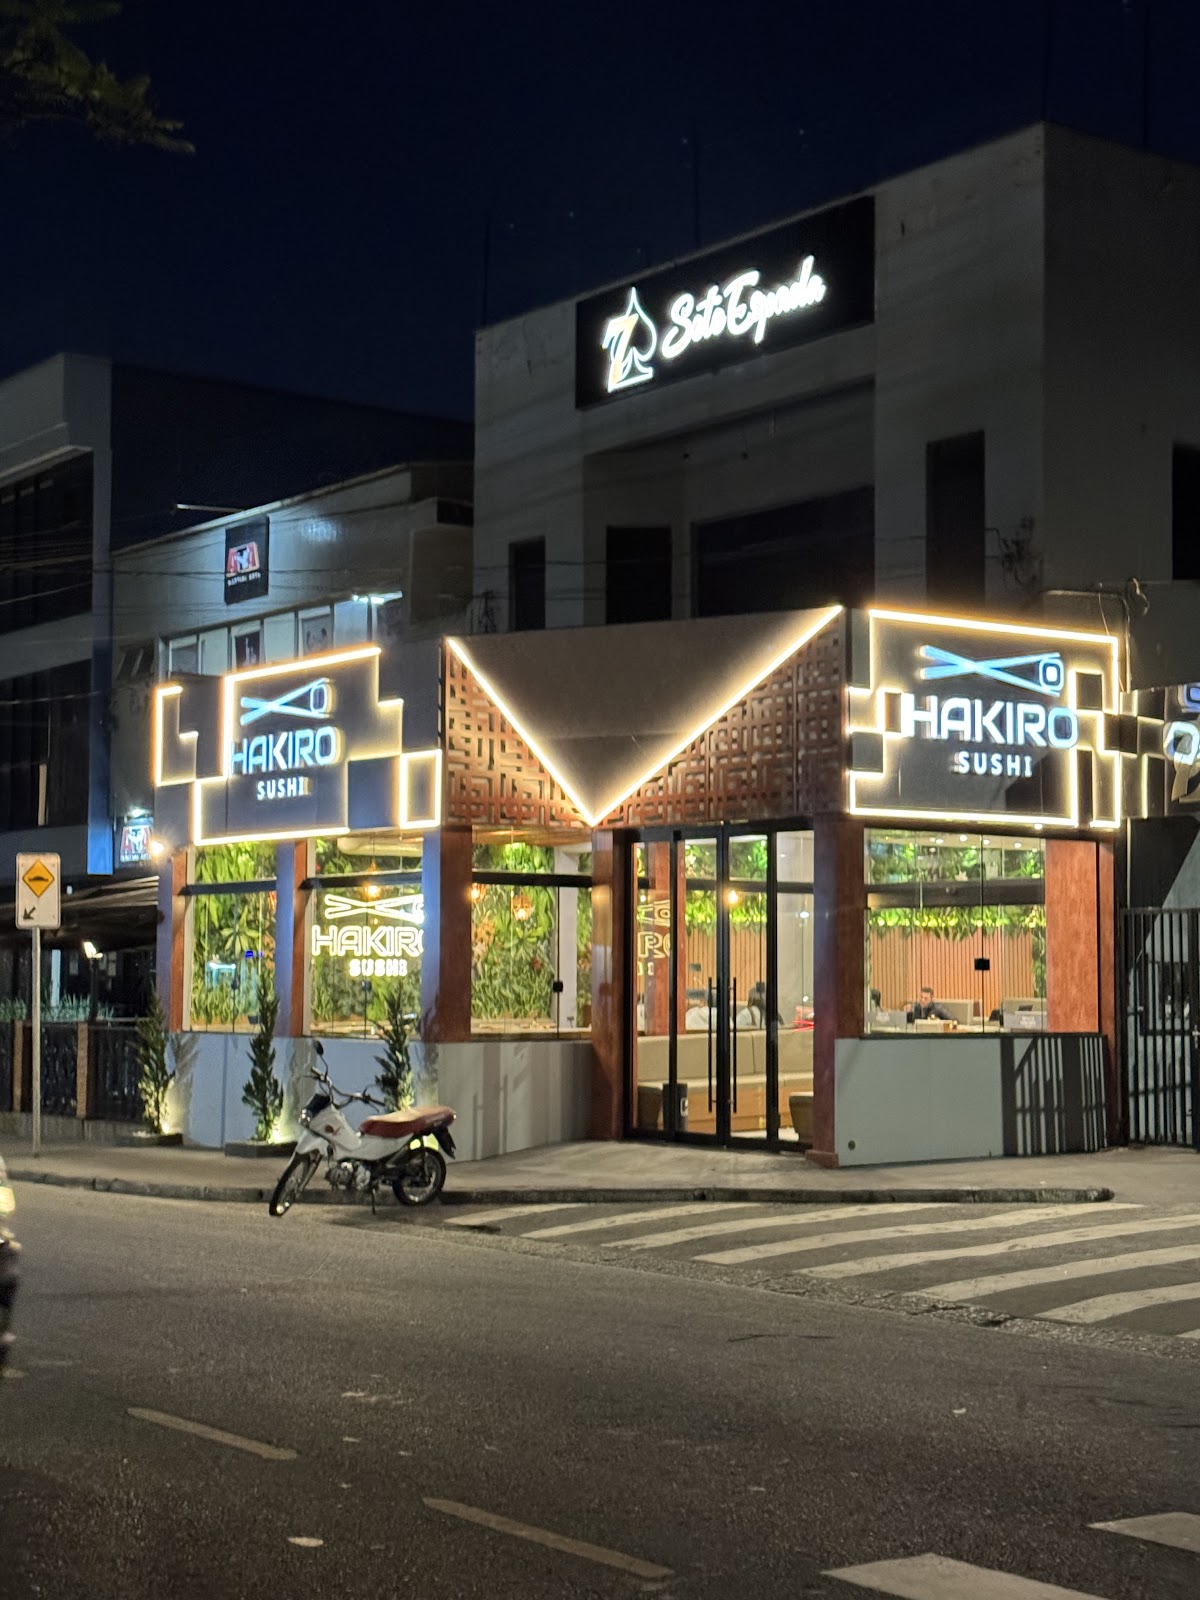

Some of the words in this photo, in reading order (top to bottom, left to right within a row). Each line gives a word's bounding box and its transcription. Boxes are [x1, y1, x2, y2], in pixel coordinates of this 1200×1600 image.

[900, 692, 1078, 749] HAKIRO
[230, 726, 337, 775] HAKIRO
[957, 751, 1033, 778] SUSHI
[257, 776, 305, 800] SUSHI
[349, 958, 408, 977] SUSHI
